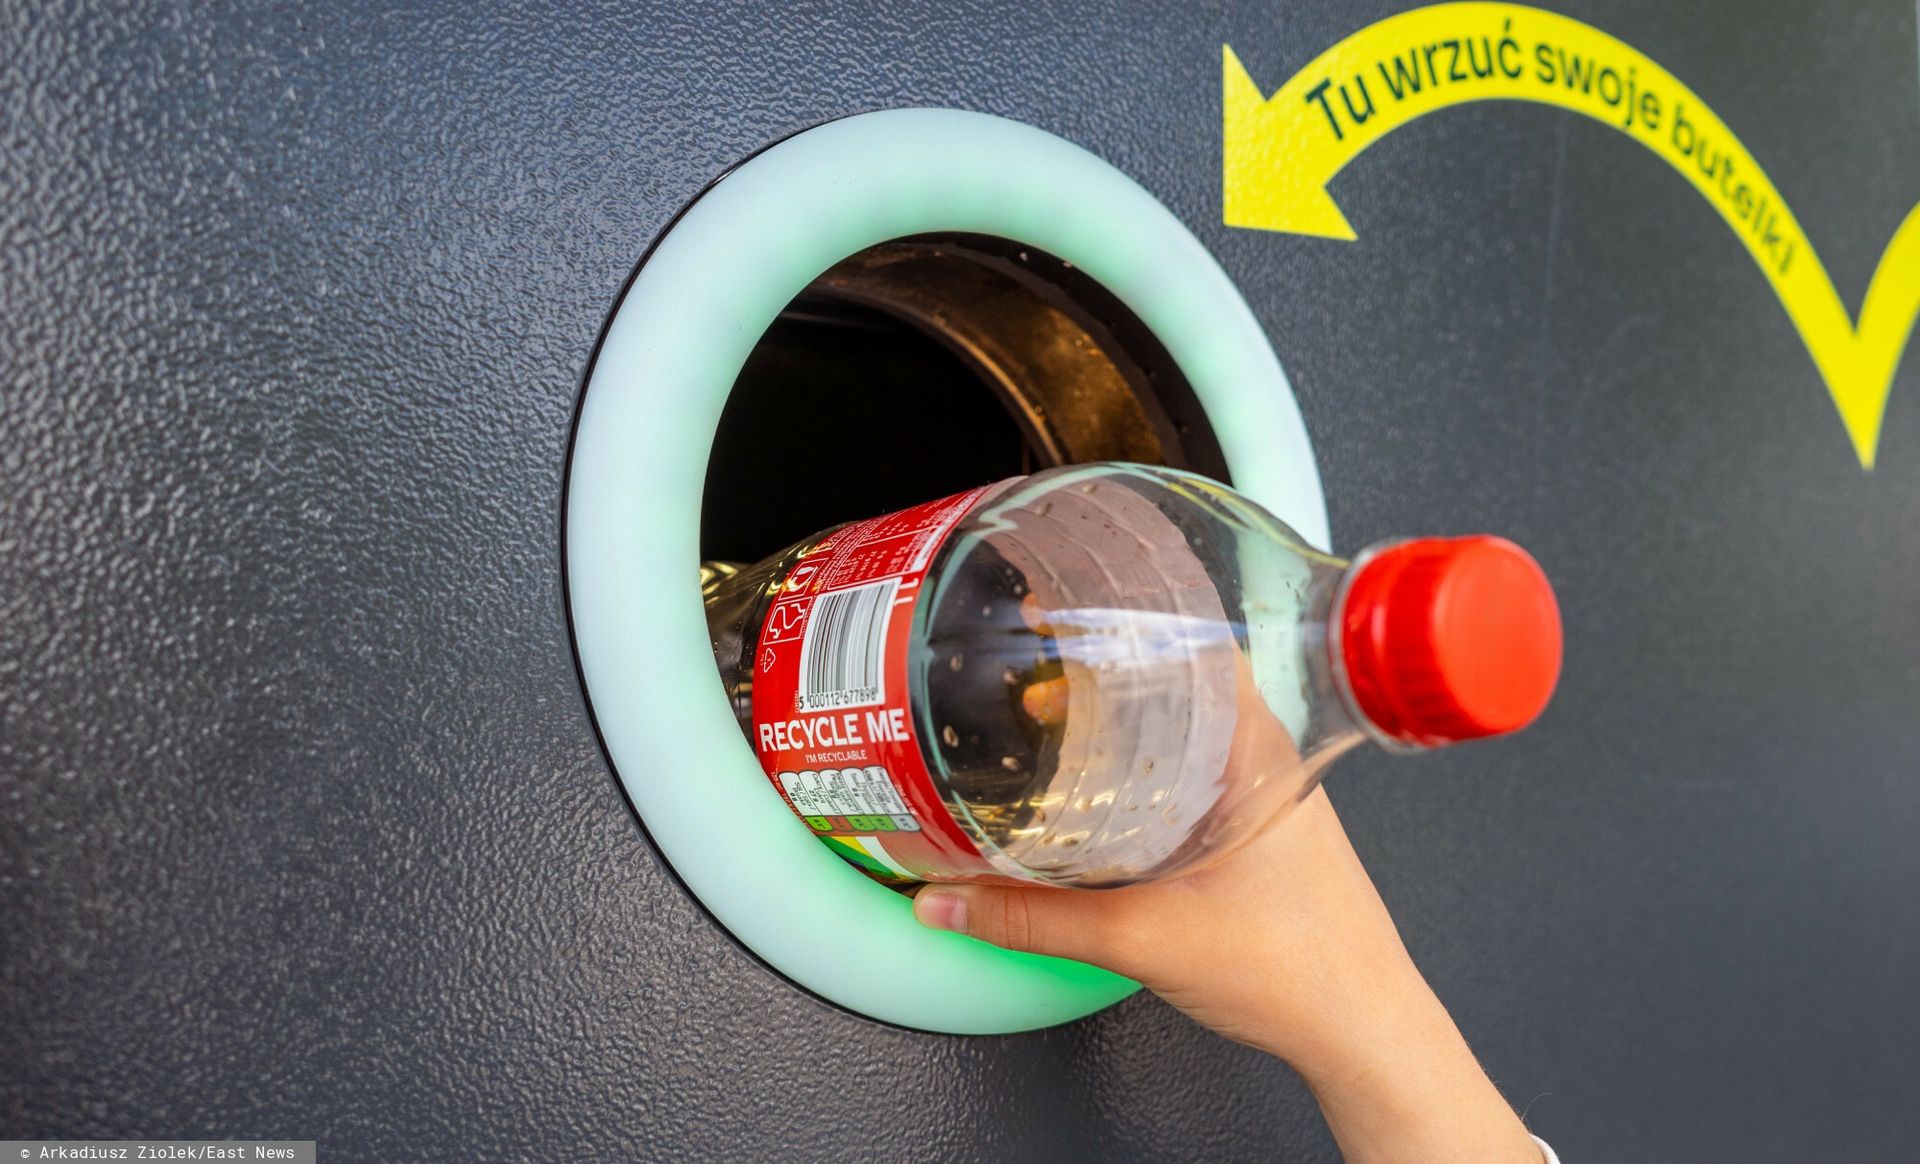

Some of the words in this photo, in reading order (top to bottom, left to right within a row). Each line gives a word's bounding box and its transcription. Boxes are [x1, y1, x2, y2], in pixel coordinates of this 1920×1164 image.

[1305, 78, 1376, 141] Tu
[1378, 18, 1522, 100] wrzuć
[1535, 43, 1662, 128] swoje
[1670, 100, 1796, 275] butelki
[759, 713, 863, 752] RECYCLE
[865, 708, 910, 744] ME
[805, 753, 817, 764] I'M
[818, 749, 868, 762] RECYCLABLE
